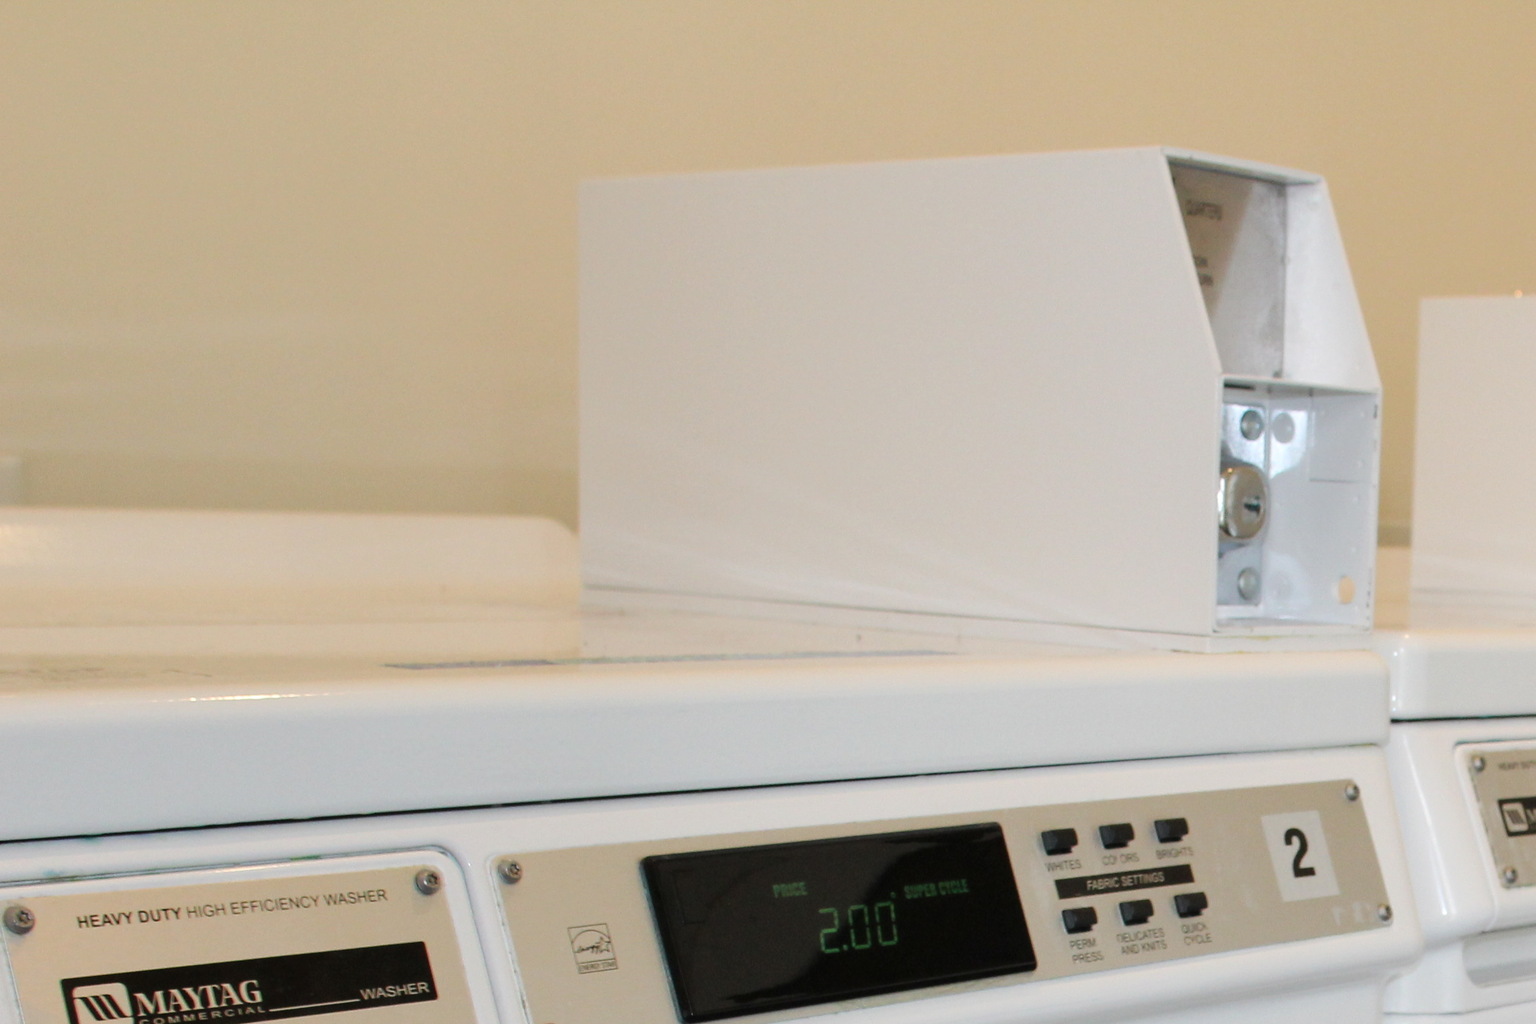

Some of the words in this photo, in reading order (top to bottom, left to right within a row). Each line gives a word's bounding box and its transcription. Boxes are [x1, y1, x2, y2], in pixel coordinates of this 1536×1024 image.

[1045, 858, 1082, 873] WHITES
[1156, 846, 1194, 860] BRIGHTS
[1284, 827, 1316, 878] 2
[772, 881, 808, 898] PRICE
[904, 882, 937, 899] SUPER
[938, 878, 970, 897] CYCLE
[1086, 875, 1120, 892] FABRIC
[1121, 871, 1165, 888] SETTINGS
[76, 910, 133, 929] HEAVY
[138, 906, 182, 924] DUTY
[186, 903, 227, 919] HIGH
[230, 894, 320, 915] EFFICIENCY
[323, 888, 388, 906] WASHER
[818, 901, 898, 954] 2.00
[1116, 927, 1165, 943] DELICATES
[1181, 922, 1208, 935] QUICK
[1069, 937, 1097, 951] PERM
[1121, 942, 1140, 955] AND
[1140, 939, 1168, 953] KNITS
[1183, 933, 1212, 946] CYCLE
[1072, 951, 1104, 964] PRESS
[133, 979, 263, 1017] MAYTAG
[360, 981, 430, 1000] WASHER
